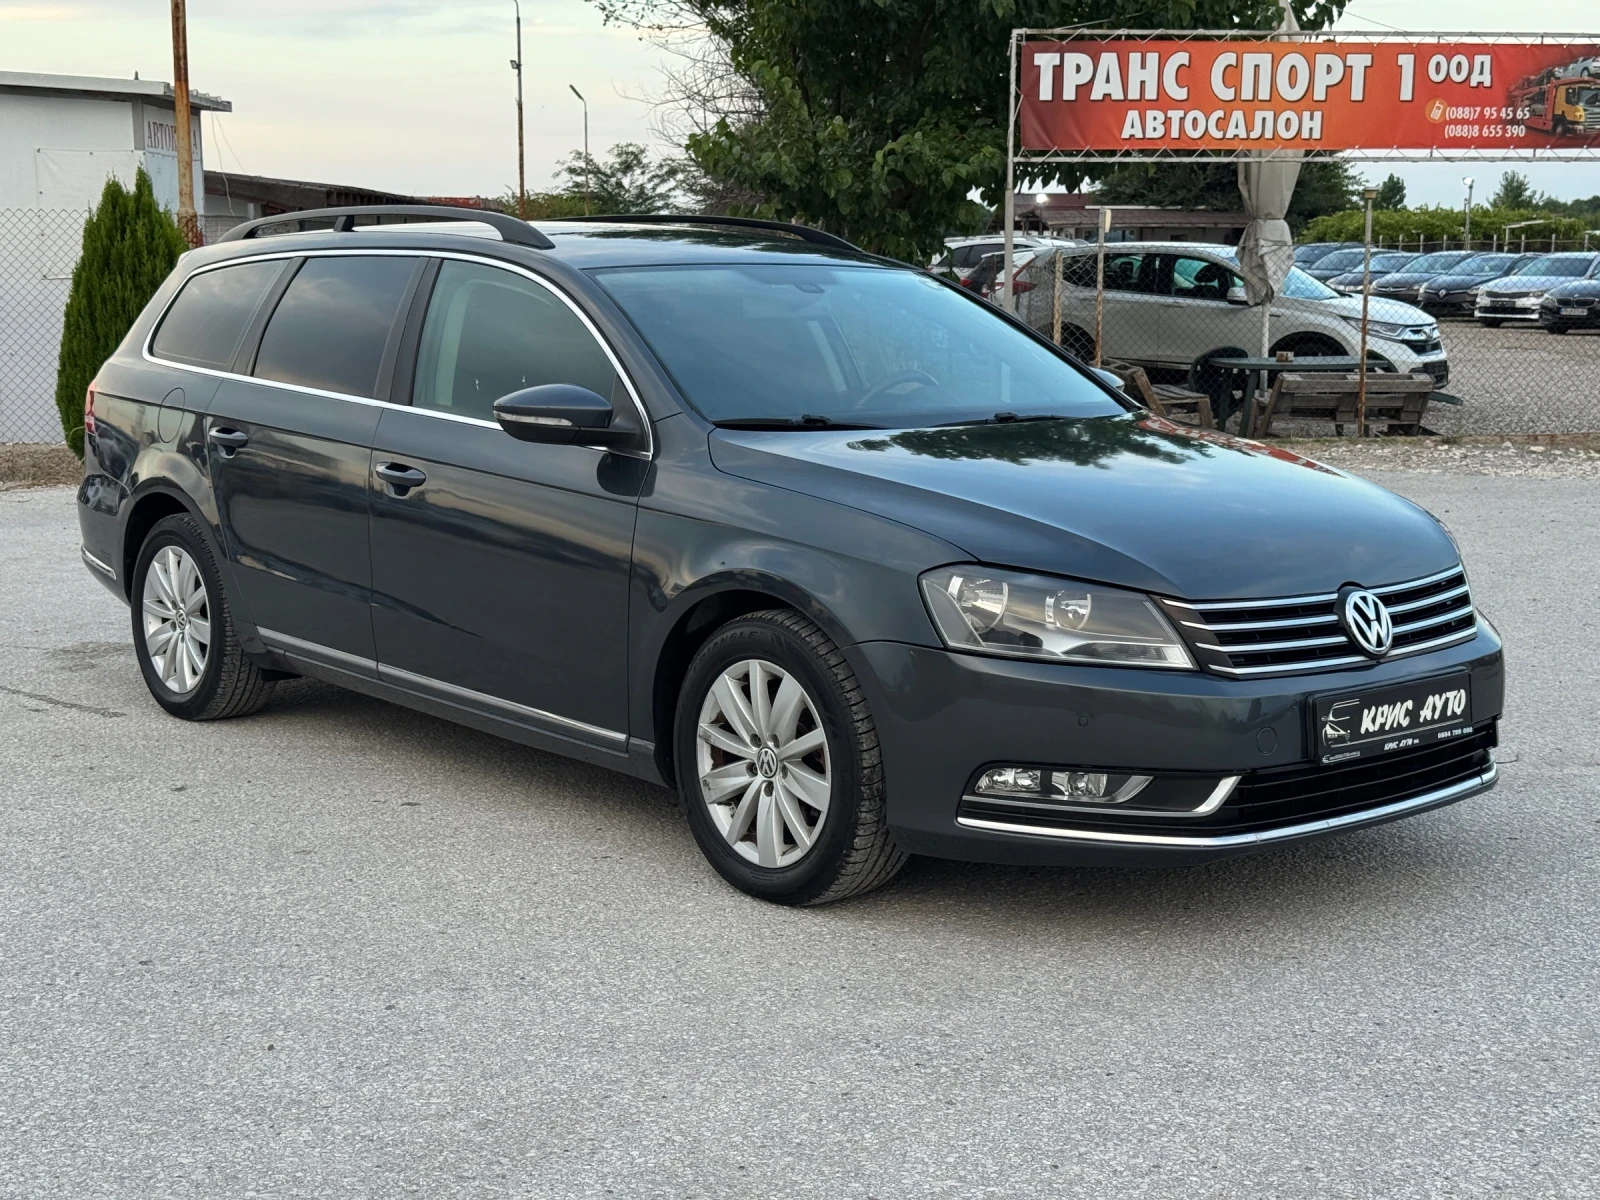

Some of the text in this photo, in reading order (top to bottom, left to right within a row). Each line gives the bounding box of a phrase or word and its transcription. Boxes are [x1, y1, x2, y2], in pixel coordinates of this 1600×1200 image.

[1033, 52, 1492, 101] ТРАНС СПОРТ 1 ООД
[1120, 110, 1323, 140] АВТОСАЛОН
[1445, 106, 1530, 121] (088)7 95 45 65
[1444, 125, 1526, 139] (088)8 655 390
[1360, 689, 1466, 734] КРИС АУТО
